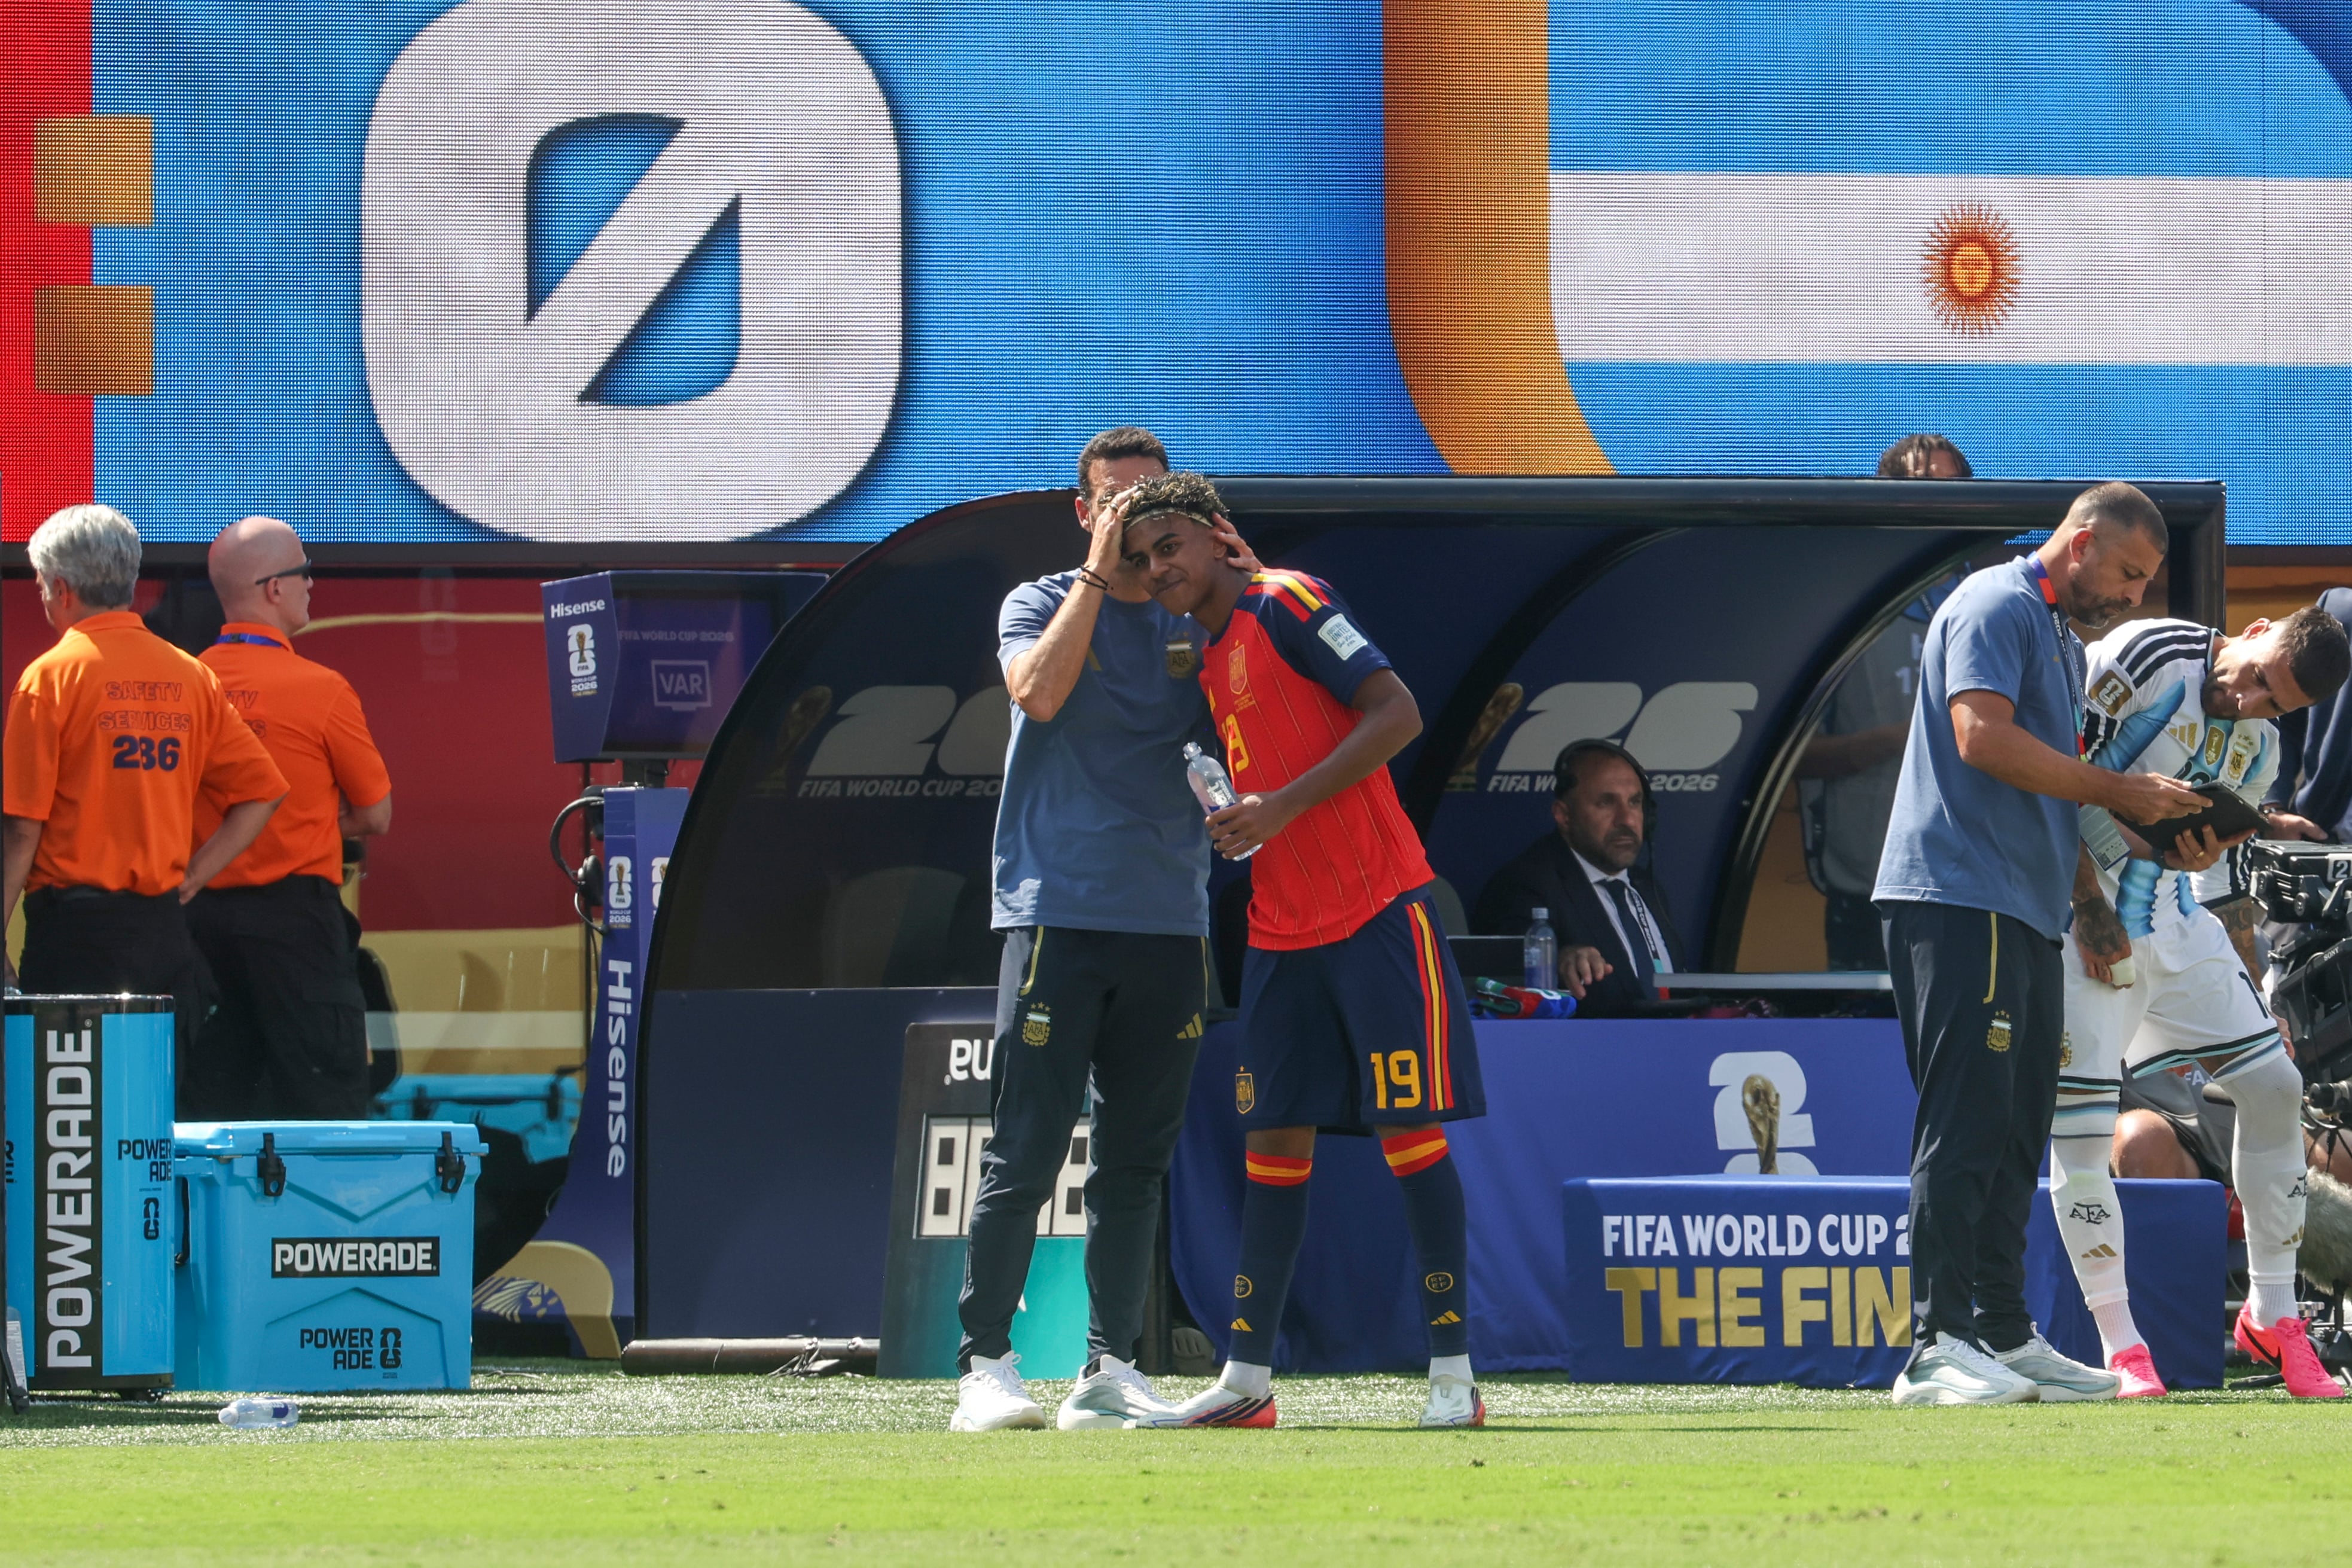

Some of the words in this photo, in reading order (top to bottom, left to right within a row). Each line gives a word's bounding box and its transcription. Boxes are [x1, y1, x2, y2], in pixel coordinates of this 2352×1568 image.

[551, 599, 605, 619] Hisense
[641, 631, 676, 641] WORLD
[678, 631, 698, 641] CUP
[699, 632, 735, 642] 2026
[105, 681, 182, 701] SAFETY
[571, 681, 598, 693] 2026
[660, 673, 703, 695] VAR
[98, 710, 191, 731] SERVICES
[798, 780, 841, 798] FIFA
[846, 779, 921, 797] WORLD
[923, 779, 963, 797] CUP
[965, 779, 1003, 797] 20
[1487, 775, 1530, 793] FIFA
[1650, 774, 1720, 792] 2026
[2335, 860, 2349, 878] 2
[2323, 947, 2339, 962] SONY
[608, 959, 632, 1177] Hisense
[1370, 1050, 1422, 1109] 19
[118, 1138, 172, 1161] POWER
[150, 1161, 172, 1182] ADE
[47, 1029, 92, 1368] POWERADE
[2069, 1202, 2111, 1225] AFA
[1603, 1215, 1679, 1256] FIFA
[1682, 1213, 1811, 1256] WORLD
[1818, 1213, 1889, 1256] CUP
[274, 1242, 433, 1273] POWERADE
[1605, 1267, 1765, 1347] THE
[1781, 1266, 1912, 1347] FIN
[300, 1327, 374, 1349] POWER
[332, 1349, 373, 1370] ADE
